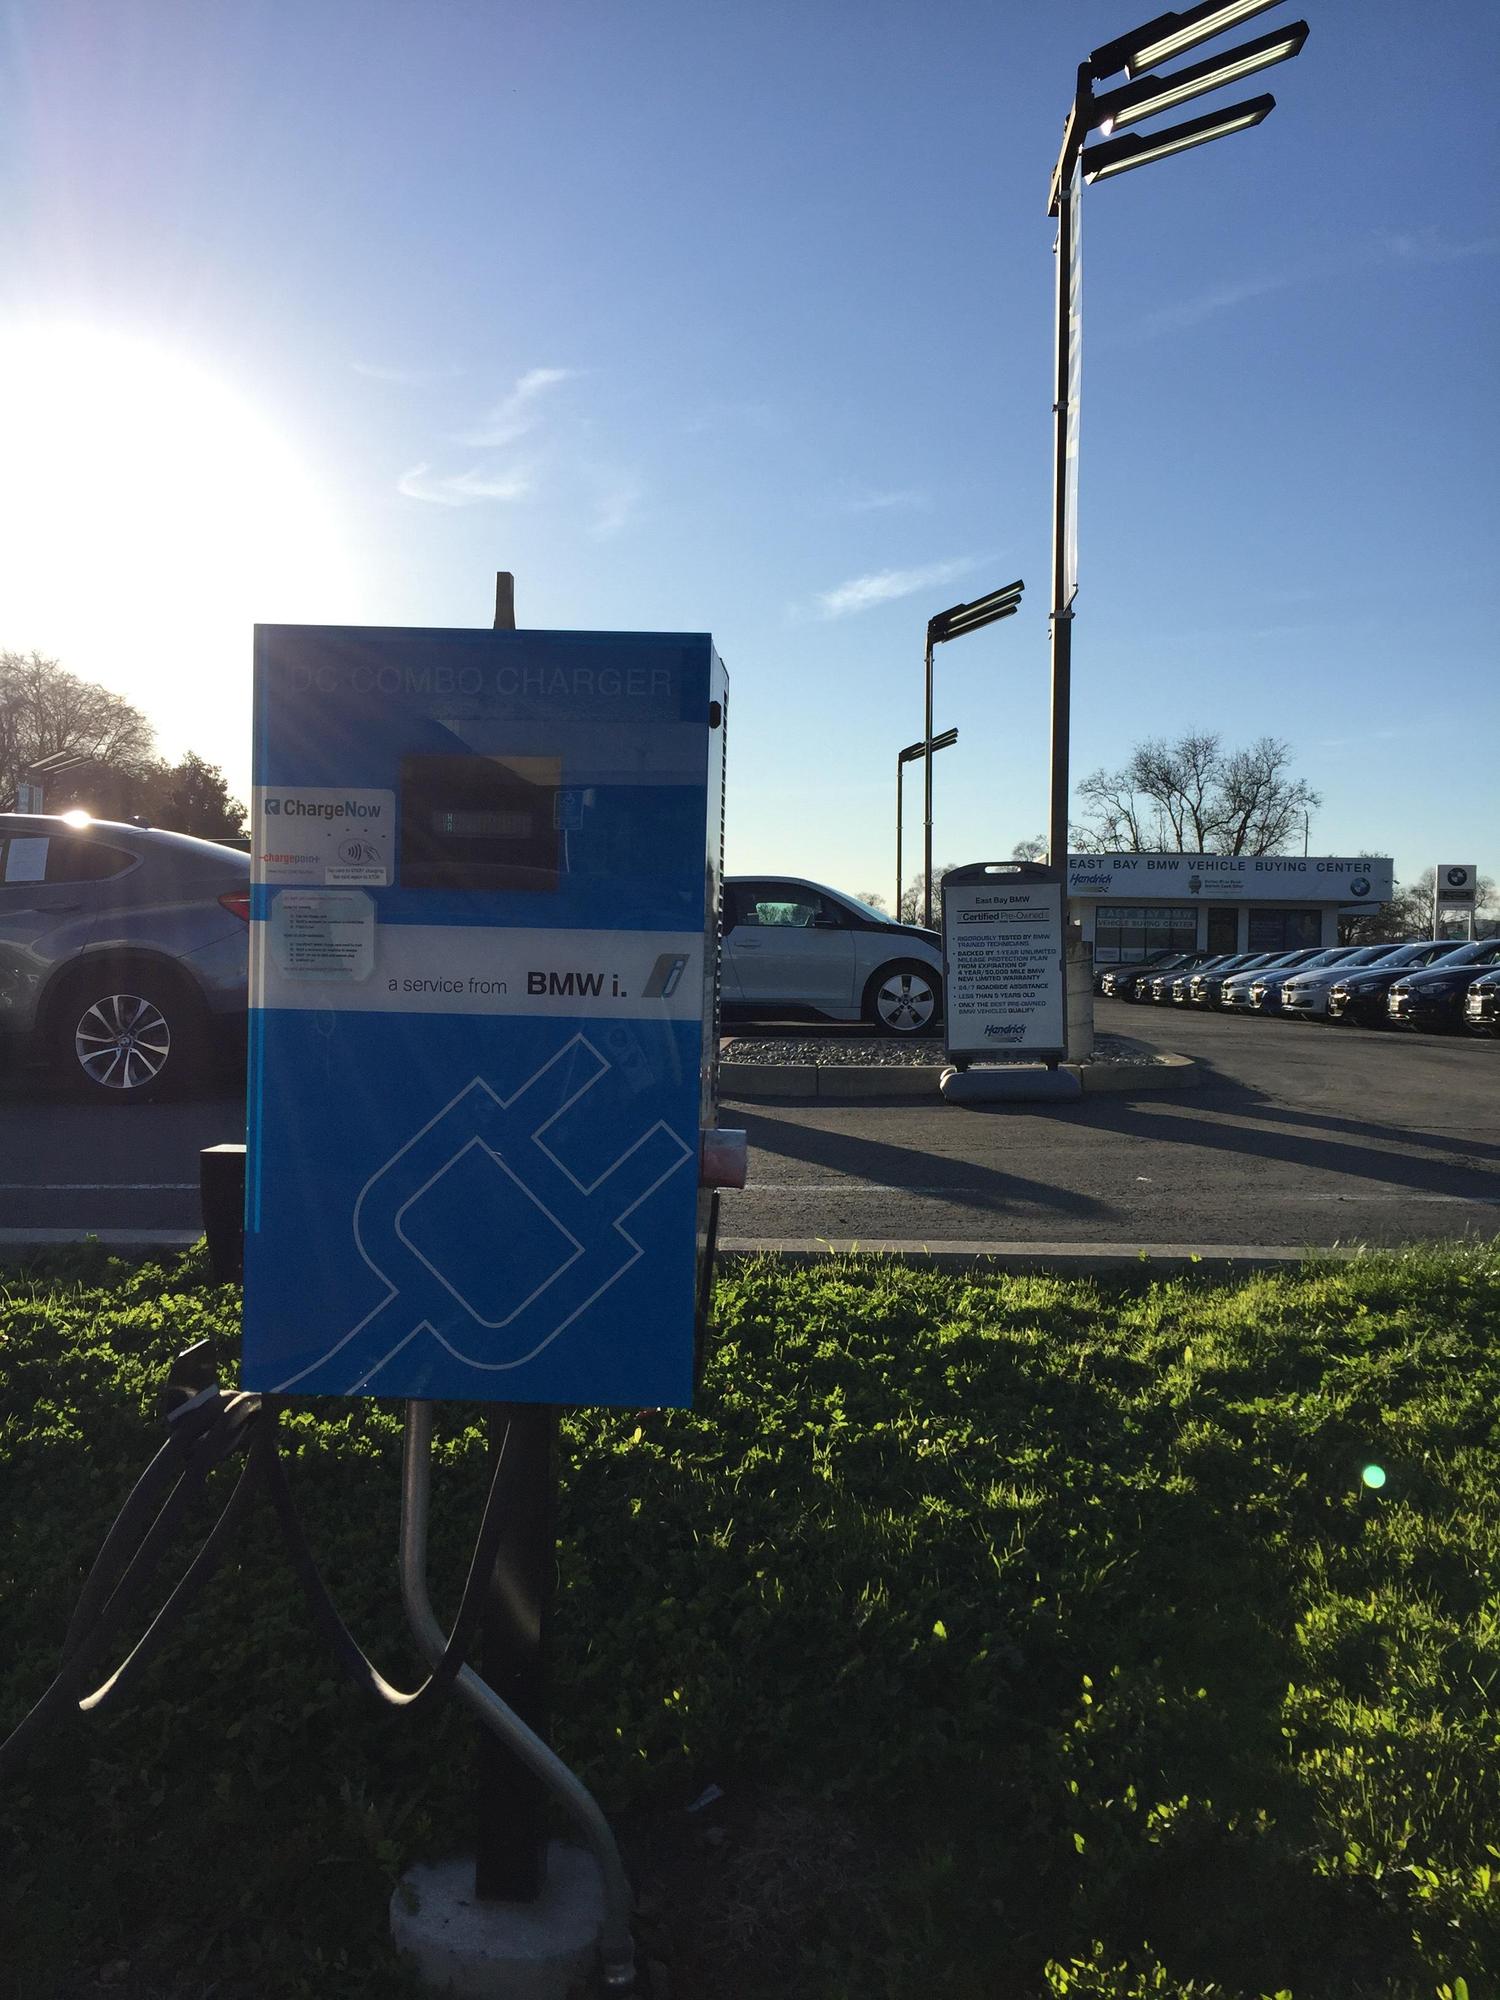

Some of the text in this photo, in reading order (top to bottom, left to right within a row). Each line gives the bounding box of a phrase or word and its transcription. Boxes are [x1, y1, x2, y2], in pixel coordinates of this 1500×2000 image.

[289, 665, 672, 697] DC COMBO CHARGER
[283, 799, 382, 820] ChargeNow
[1069, 859, 1372, 873] EAST BAY BMW VEHICLE BUYING CENTER
[975, 895, 1031, 905] East Bay BMW
[963, 912, 1000, 921] Certified
[389, 979, 398, 992] a
[403, 976, 464, 993] service
[469, 977, 508, 995] from
[527, 971, 604, 998] BMW
